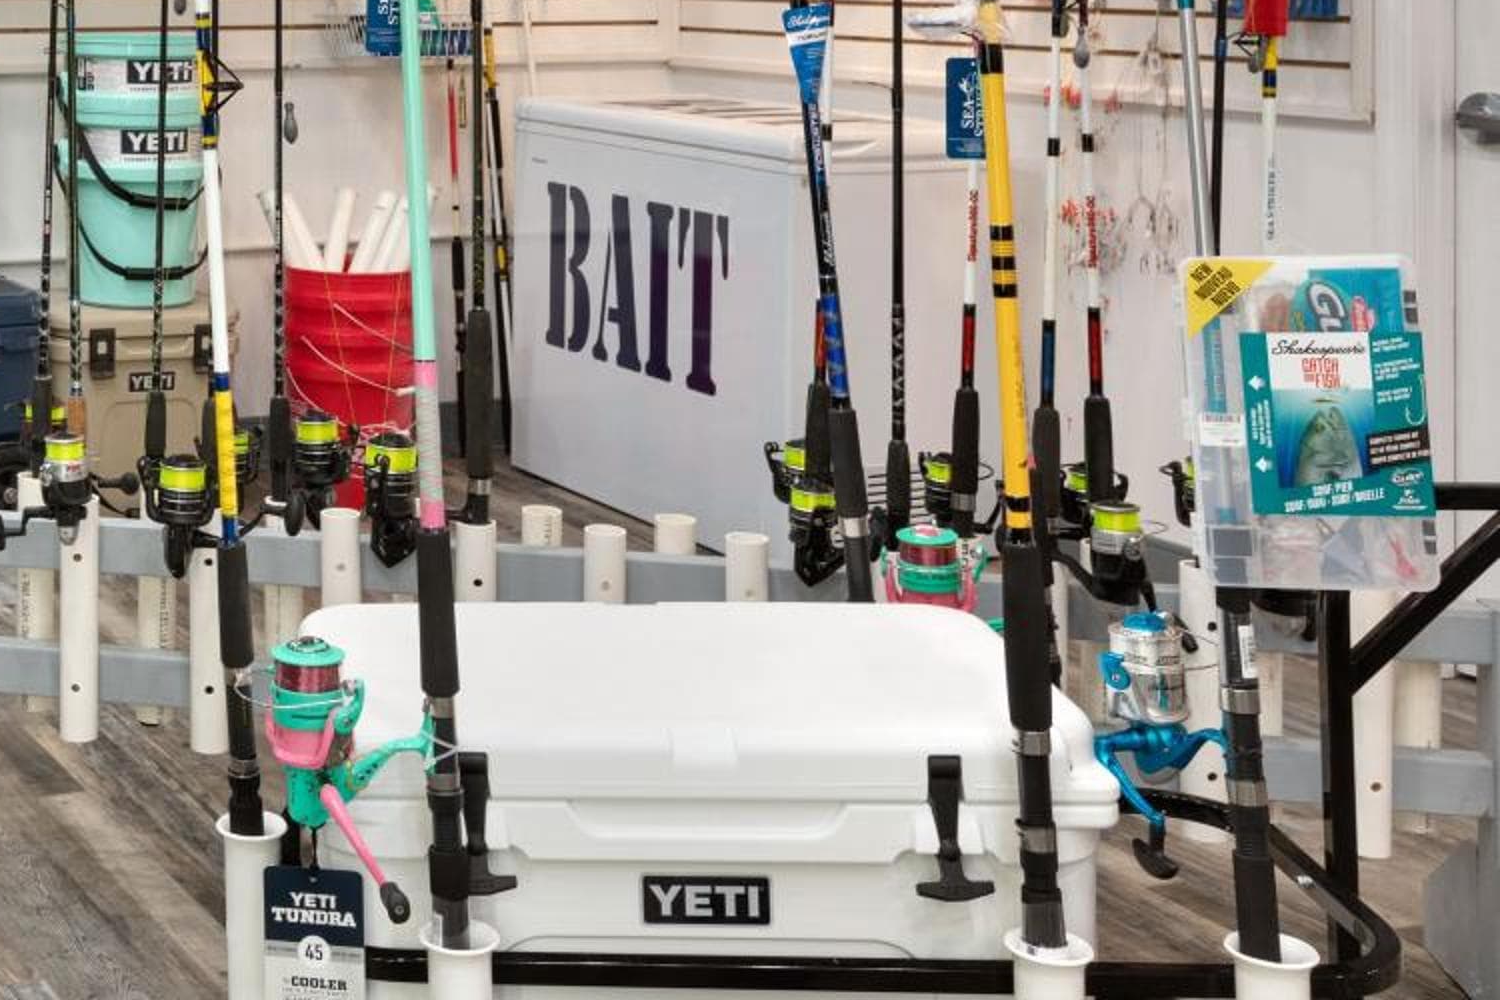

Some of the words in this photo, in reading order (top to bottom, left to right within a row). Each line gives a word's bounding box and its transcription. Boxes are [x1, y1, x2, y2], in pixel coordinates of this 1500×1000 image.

[961, 101, 975, 129] SEA
[127, 132, 185, 152] YETI
[1190, 262, 1214, 282] NEW
[546, 181, 729, 396] BAIT
[1302, 358, 1339, 373] CATCH
[1315, 374, 1341, 388] FISH
[290, 892, 337, 909] YETI
[649, 884, 760, 917] YETI
[271, 906, 357, 928] TUNDRA
[305, 944, 323, 961] 45
[291, 976, 348, 991] COOLER
